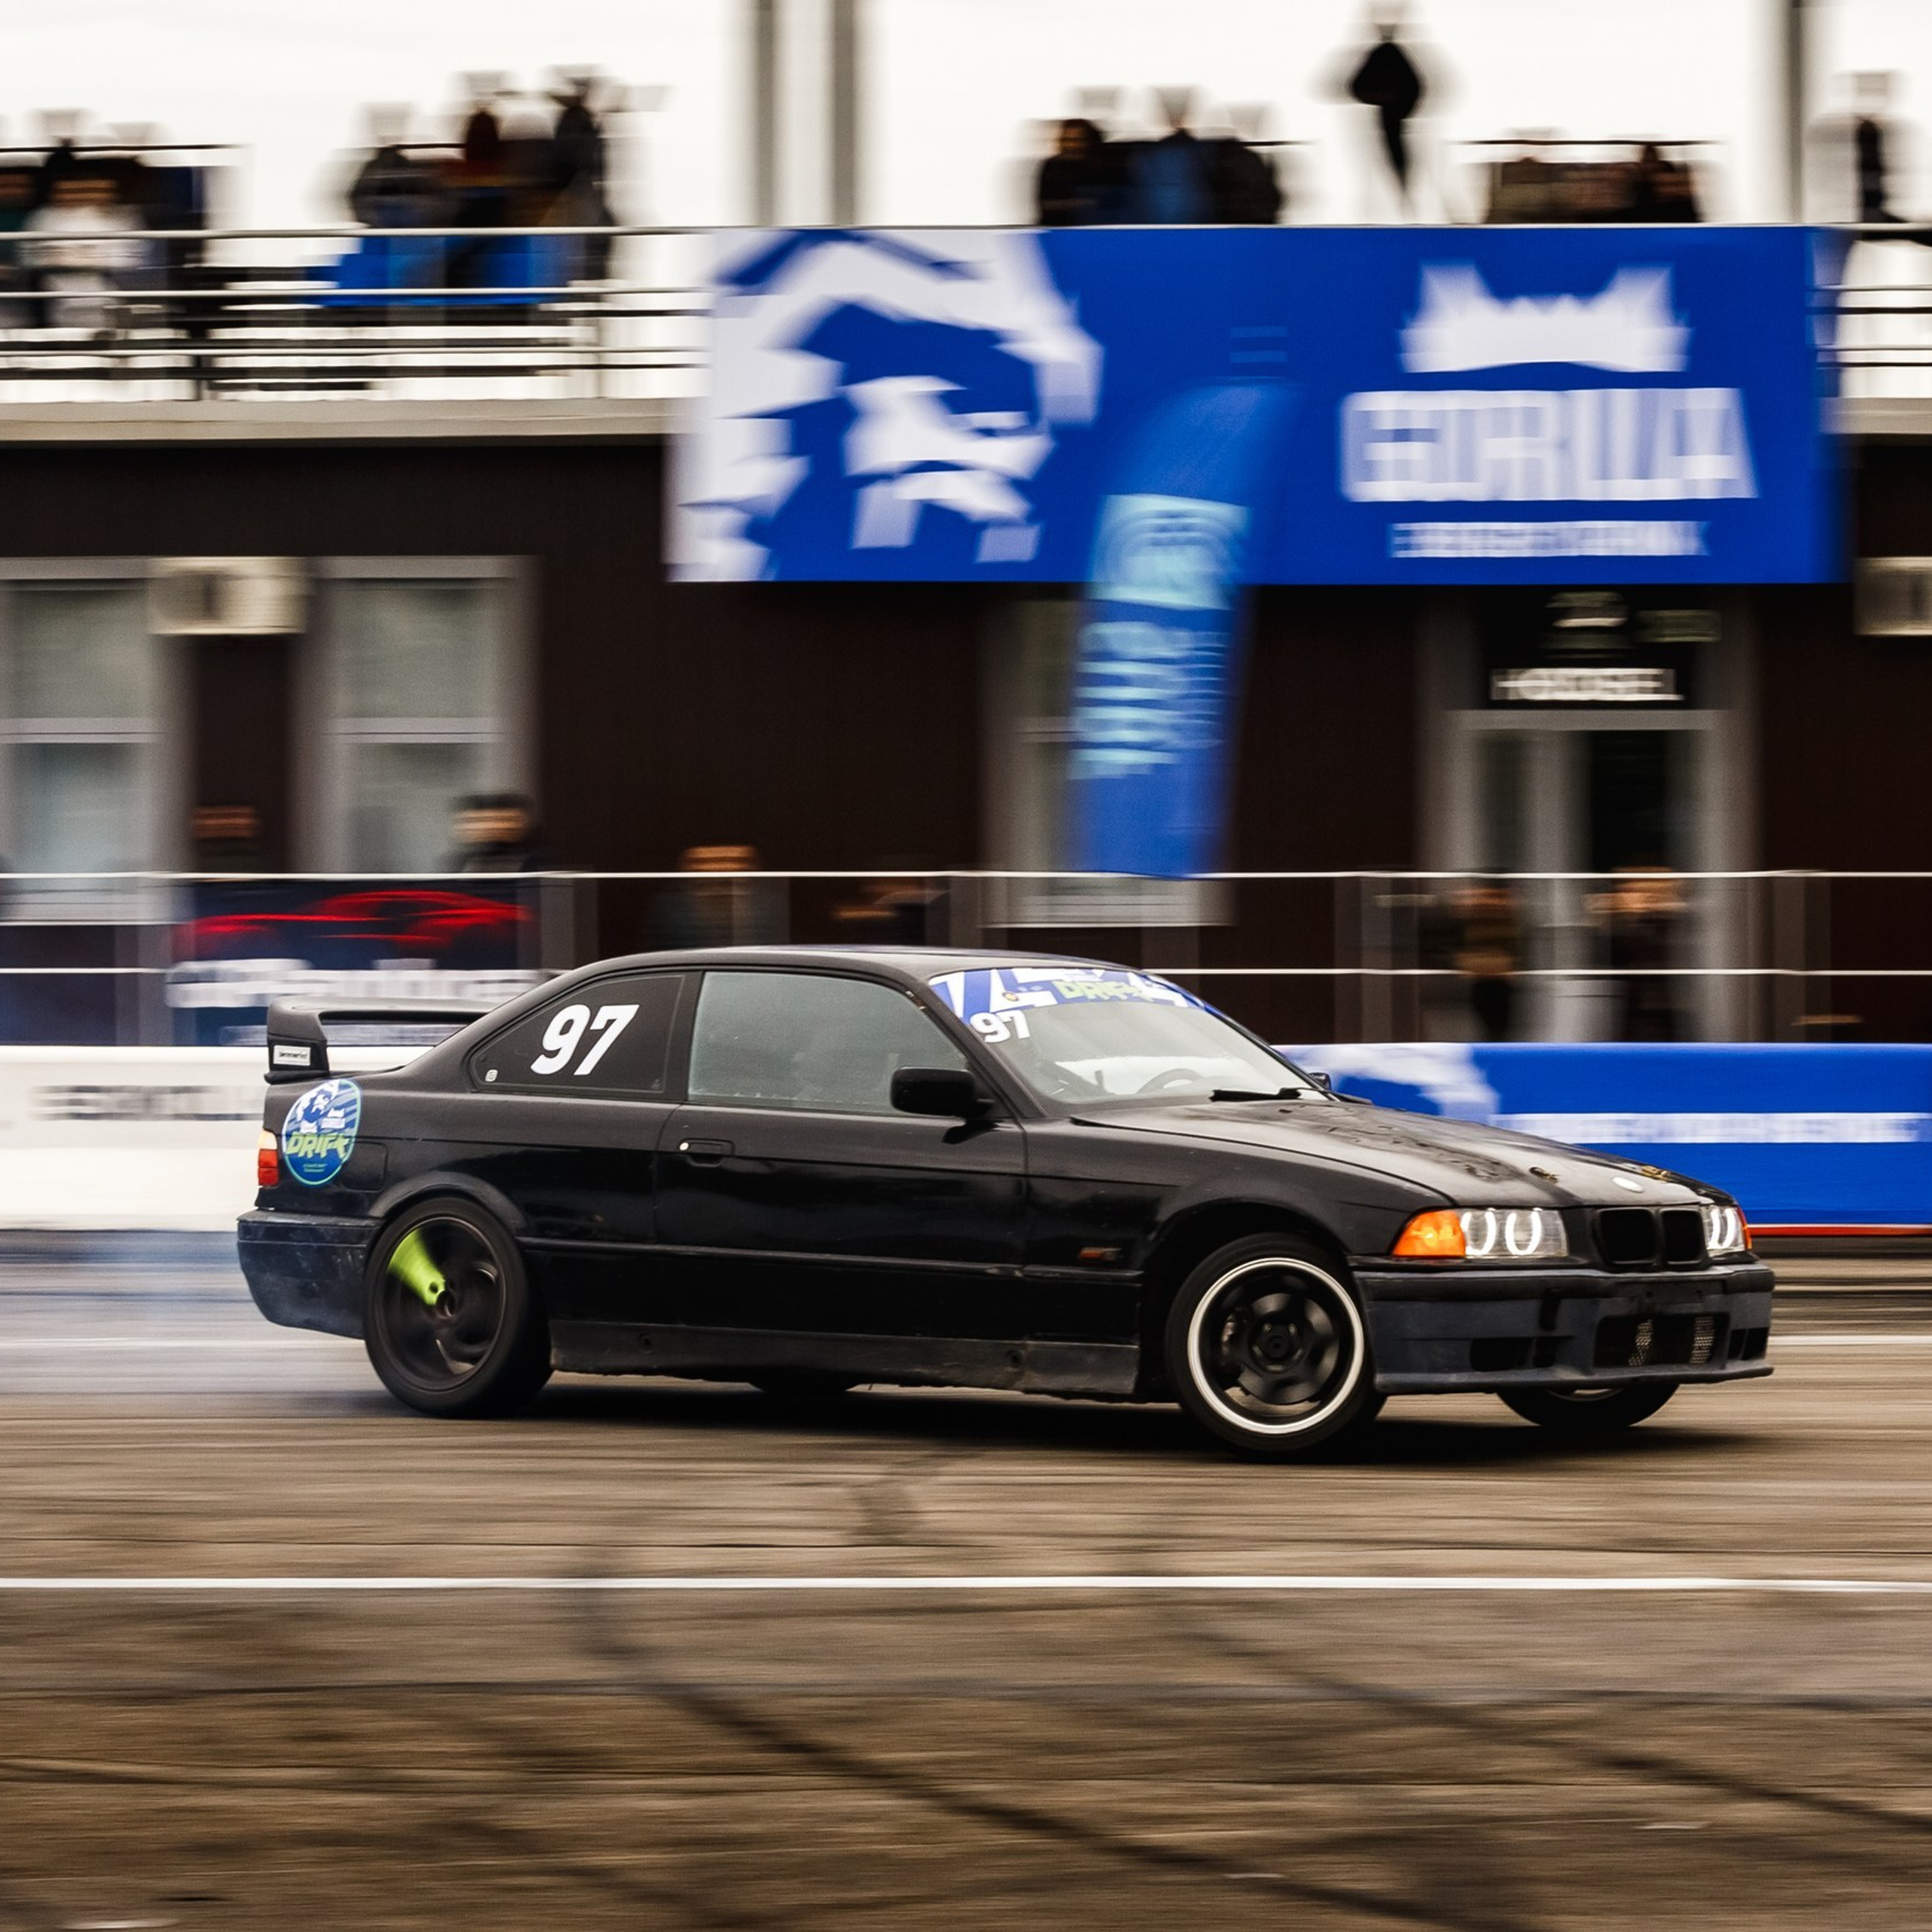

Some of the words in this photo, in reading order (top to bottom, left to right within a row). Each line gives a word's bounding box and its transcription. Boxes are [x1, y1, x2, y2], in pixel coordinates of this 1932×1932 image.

[531, 1004, 640, 1076] 97
[970, 1009, 1031, 1043] 97
[286, 1131, 350, 1158] DRIFT
